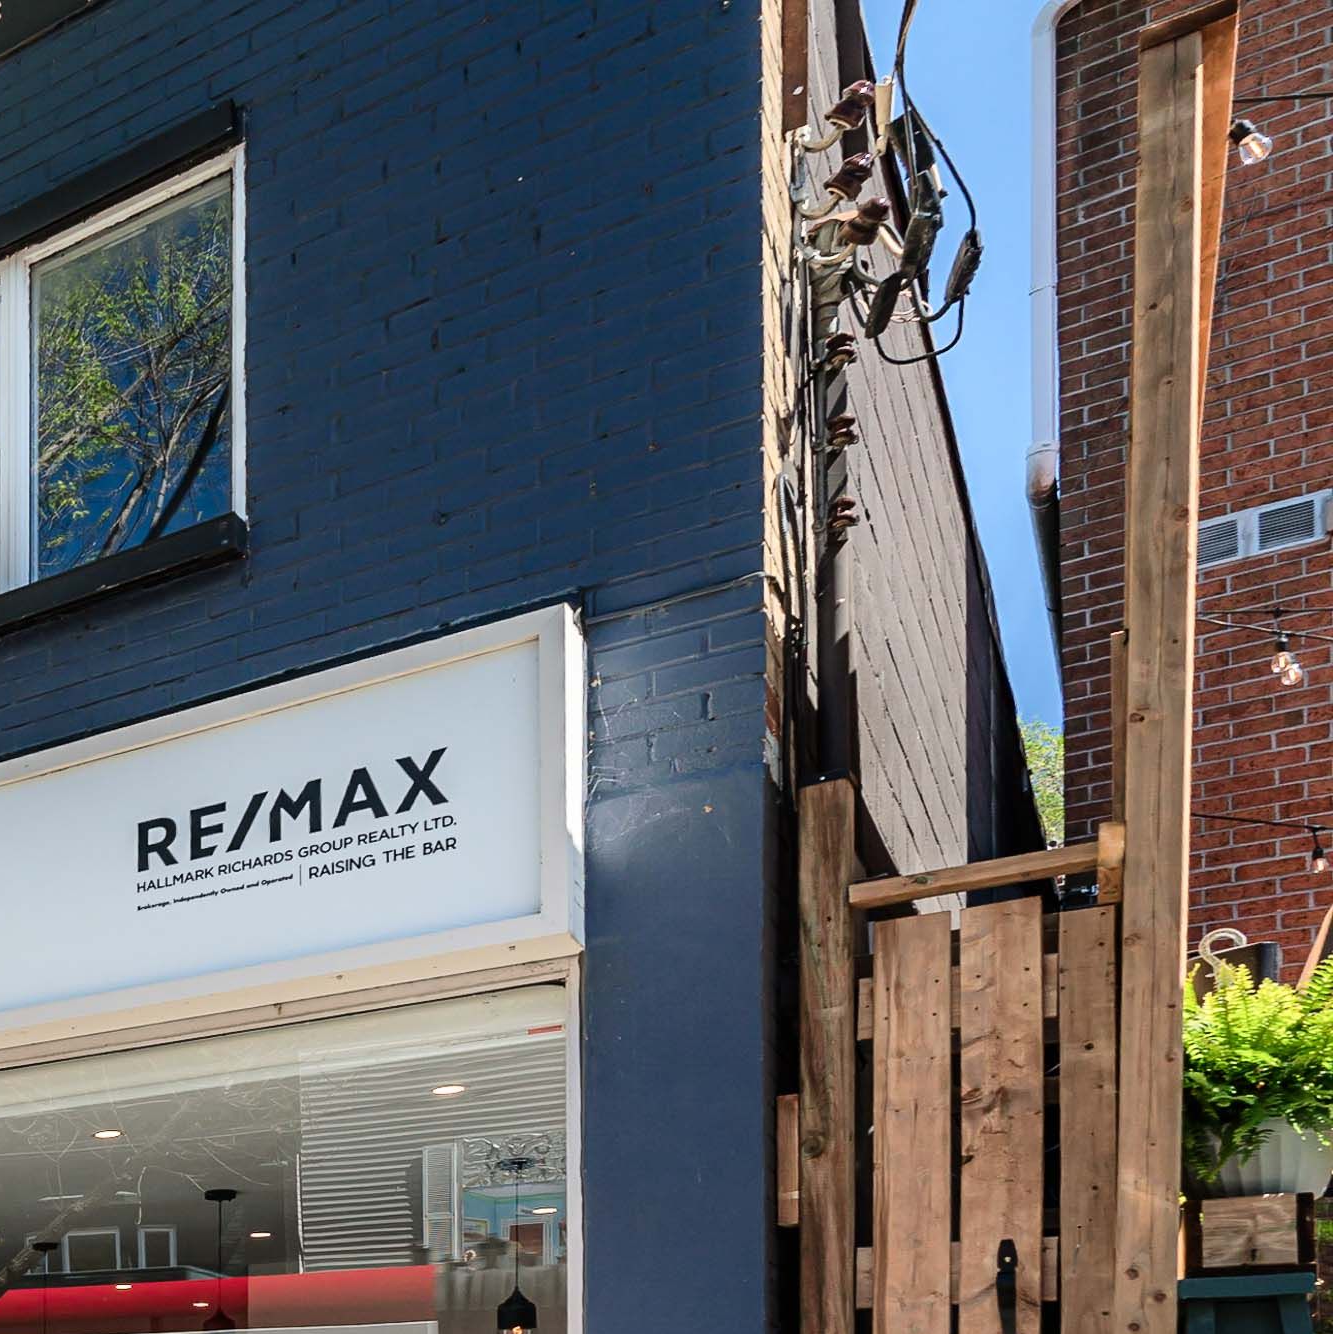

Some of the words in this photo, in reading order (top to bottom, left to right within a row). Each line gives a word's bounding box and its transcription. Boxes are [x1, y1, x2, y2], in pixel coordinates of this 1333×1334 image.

[136, 746, 450, 873] RE/MAX
[136, 867, 214, 894] HALLMARK
[218, 849, 294, 876] RICHARDS
[298, 836, 354, 858] GROUP
[357, 822, 419, 846] REALTY
[423, 814, 458, 832] LTD.
[246, 880, 259, 889] and
[308, 854, 377, 880] RAISING
[382, 845, 416, 864] THE
[422, 837, 458, 856] BAR
